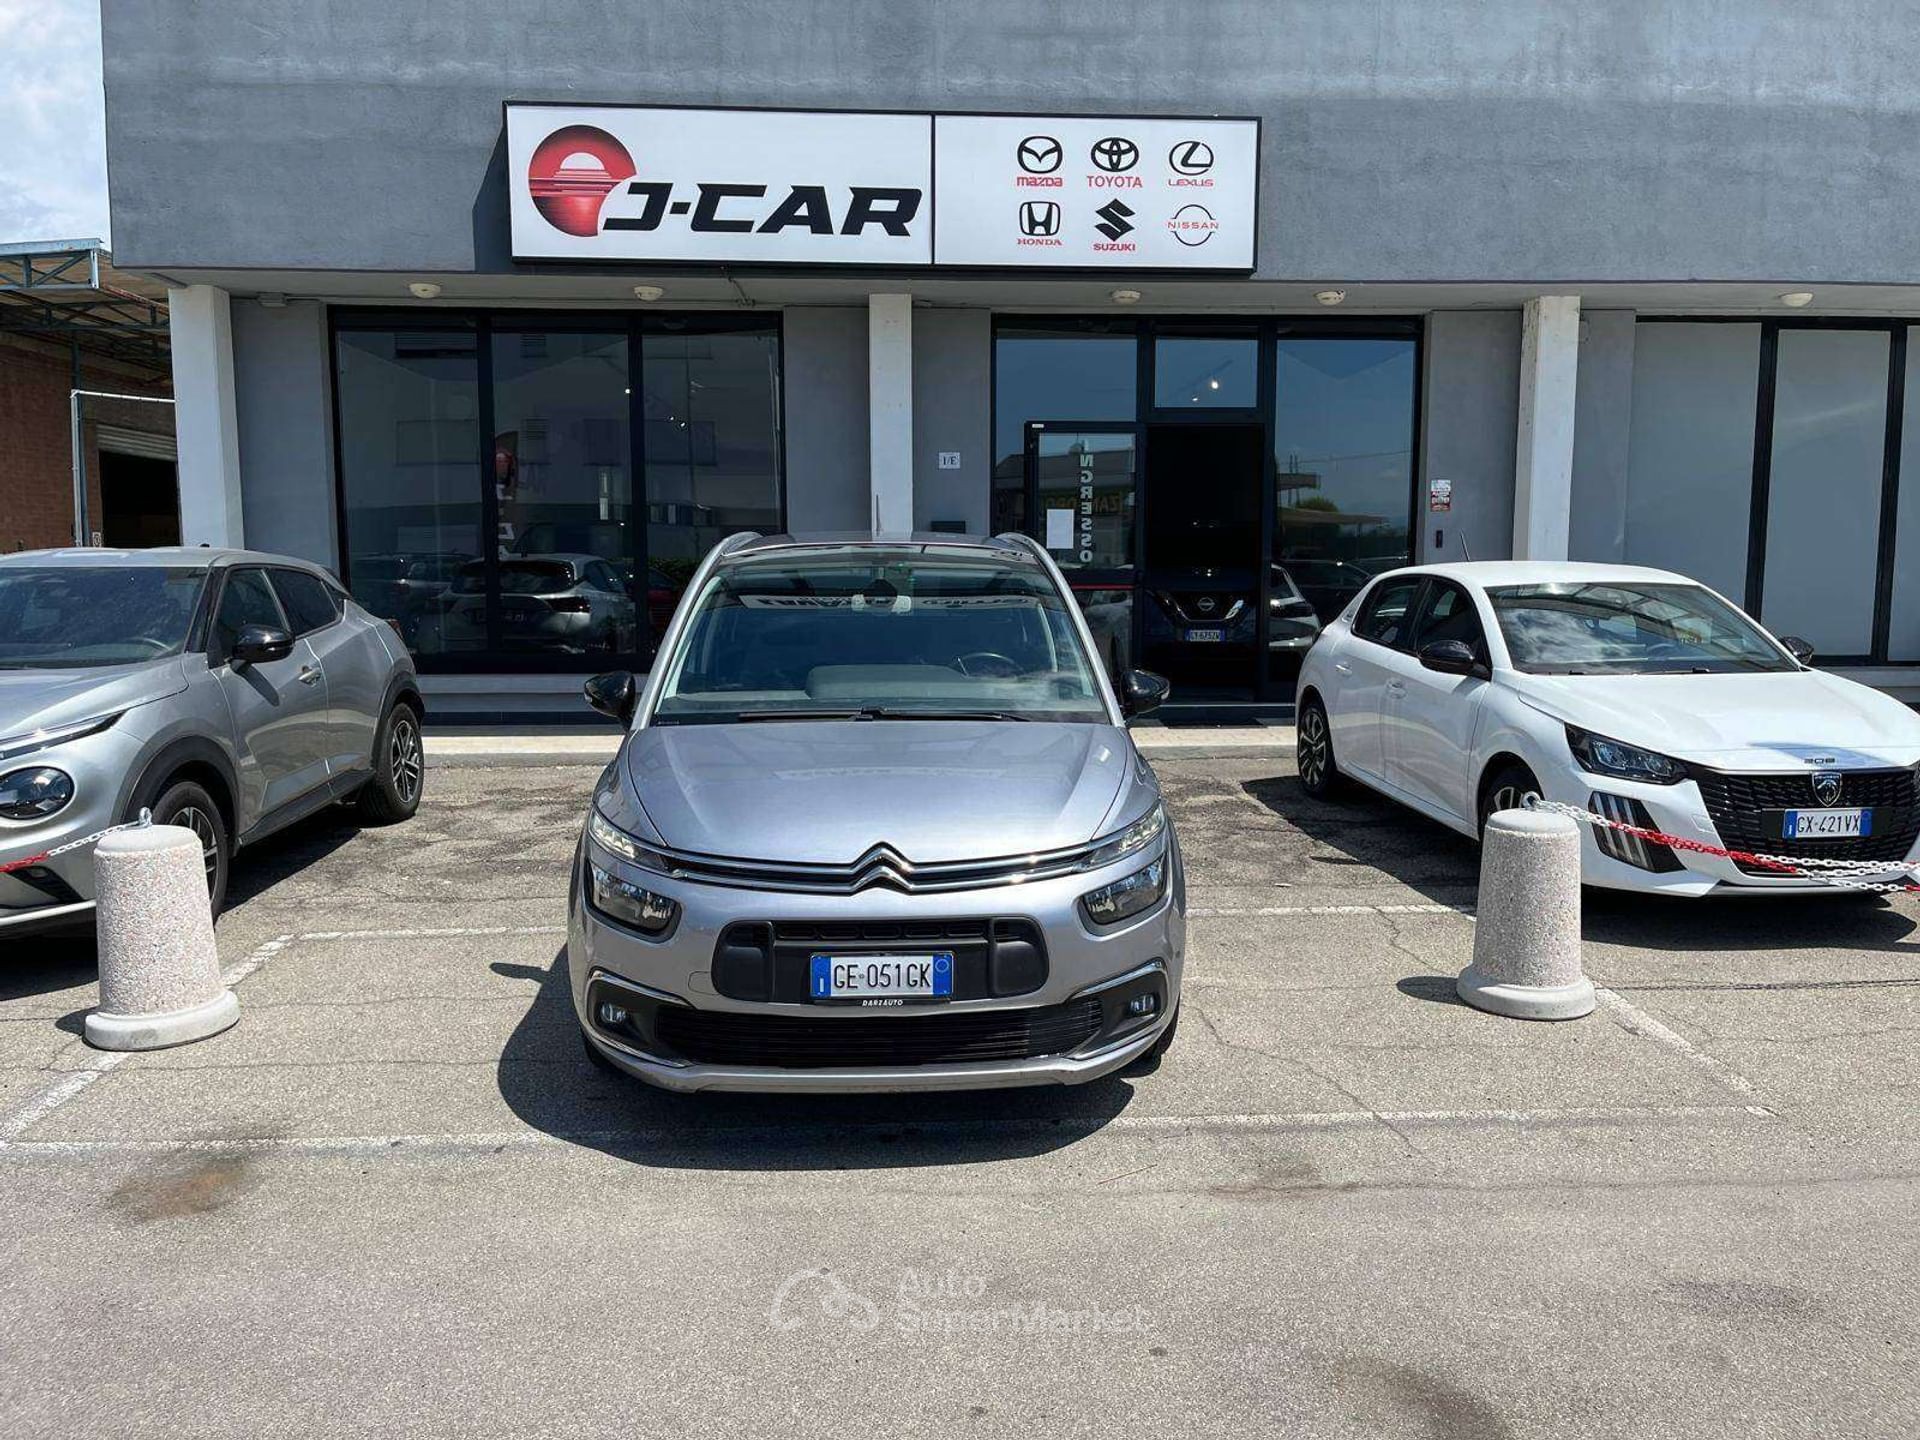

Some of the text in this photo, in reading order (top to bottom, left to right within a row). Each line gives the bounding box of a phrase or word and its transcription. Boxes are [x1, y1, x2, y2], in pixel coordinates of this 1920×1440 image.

[1086, 176, 1143, 189] TOYOTA
[1168, 178, 1214, 188] LEXUS
[602, 181, 922, 237] J-CAR
[1167, 221, 1219, 230] NISSAN
[1017, 238, 1063, 247] HONDA
[1093, 243, 1136, 252] SUZUKI
[1797, 816, 1814, 832] GX
[1818, 815, 1860, 832] 421VX
[833, 963, 858, 989] GE
[867, 963, 932, 988] 051GK
